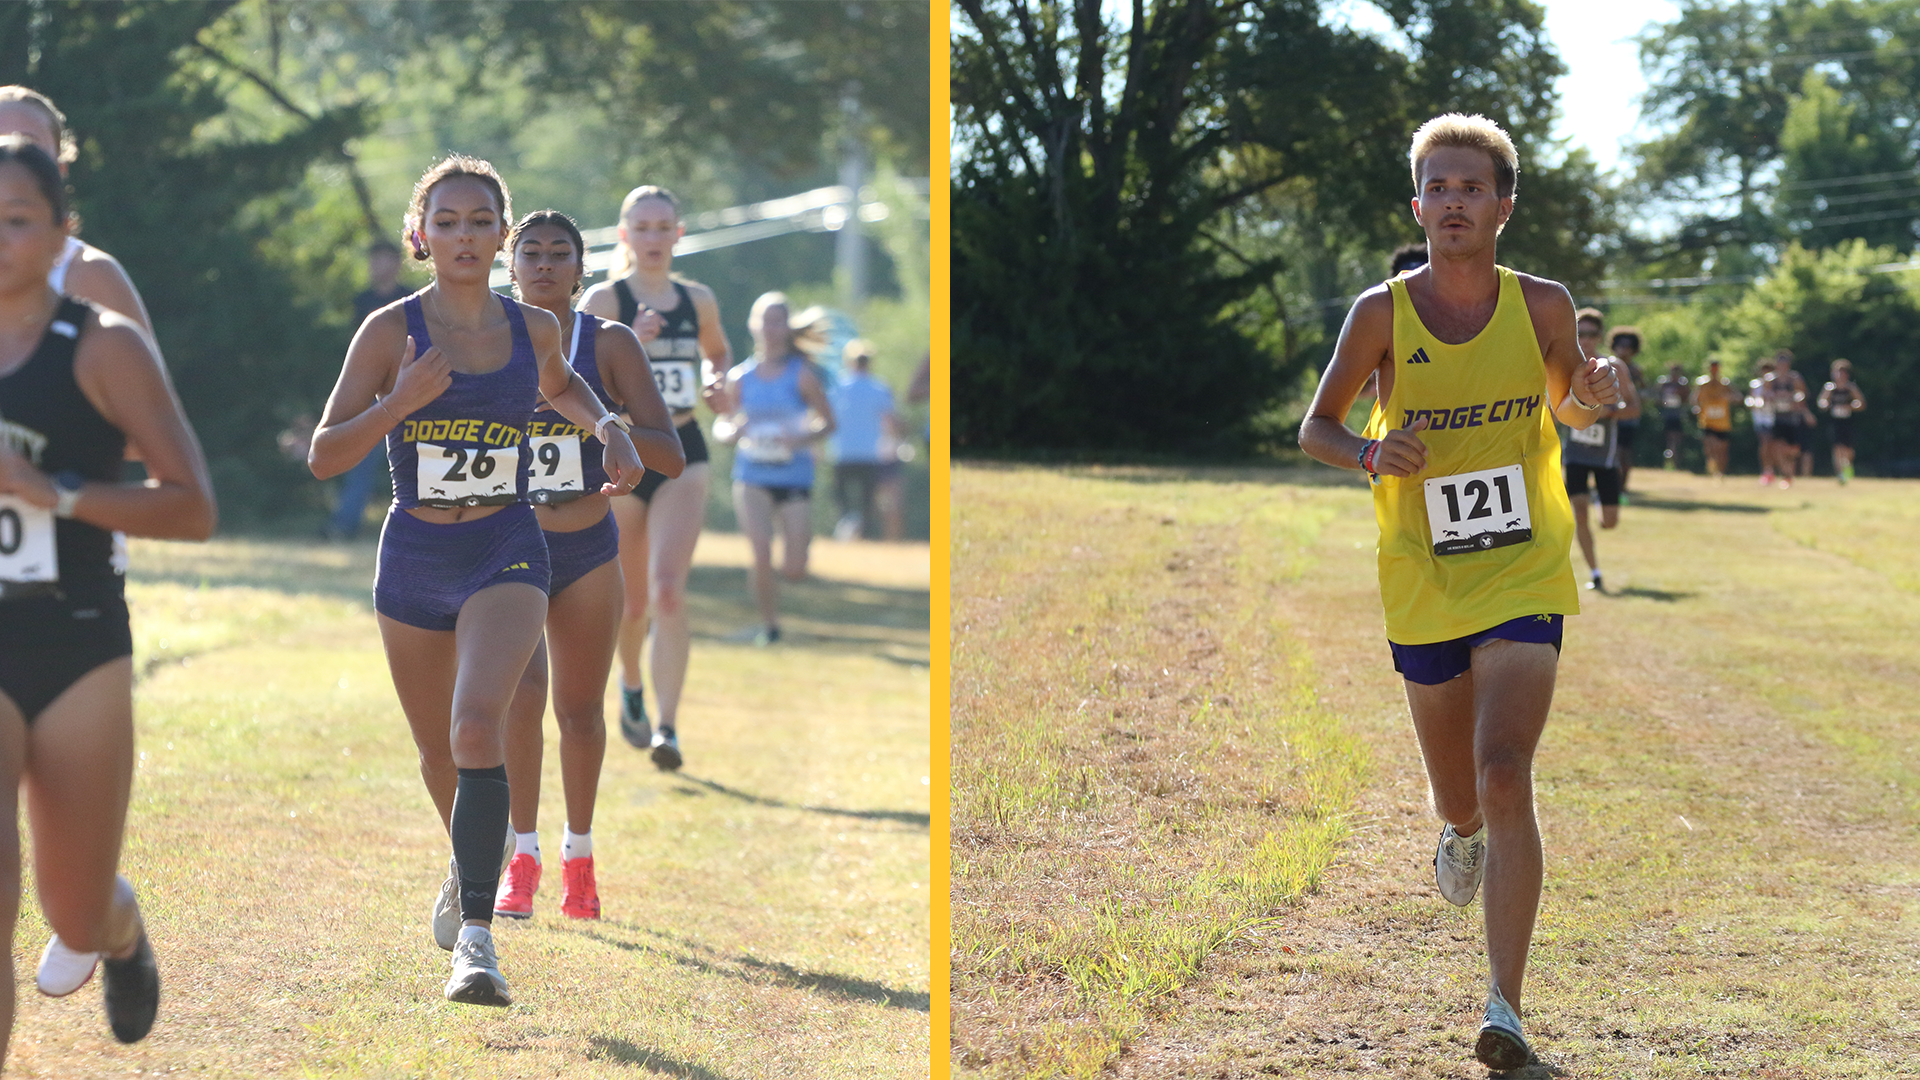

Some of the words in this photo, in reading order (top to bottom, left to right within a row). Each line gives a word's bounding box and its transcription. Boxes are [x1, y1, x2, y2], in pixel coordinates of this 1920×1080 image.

[1402, 404, 1487, 431] DODGE
[1488, 395, 1540, 423] CITY
[403, 419, 485, 443] DODGE
[484, 422, 524, 447] CITY
[548, 423, 592, 443] CITY
[441, 448, 497, 482] 26
[1441, 475, 1513, 523] 121
